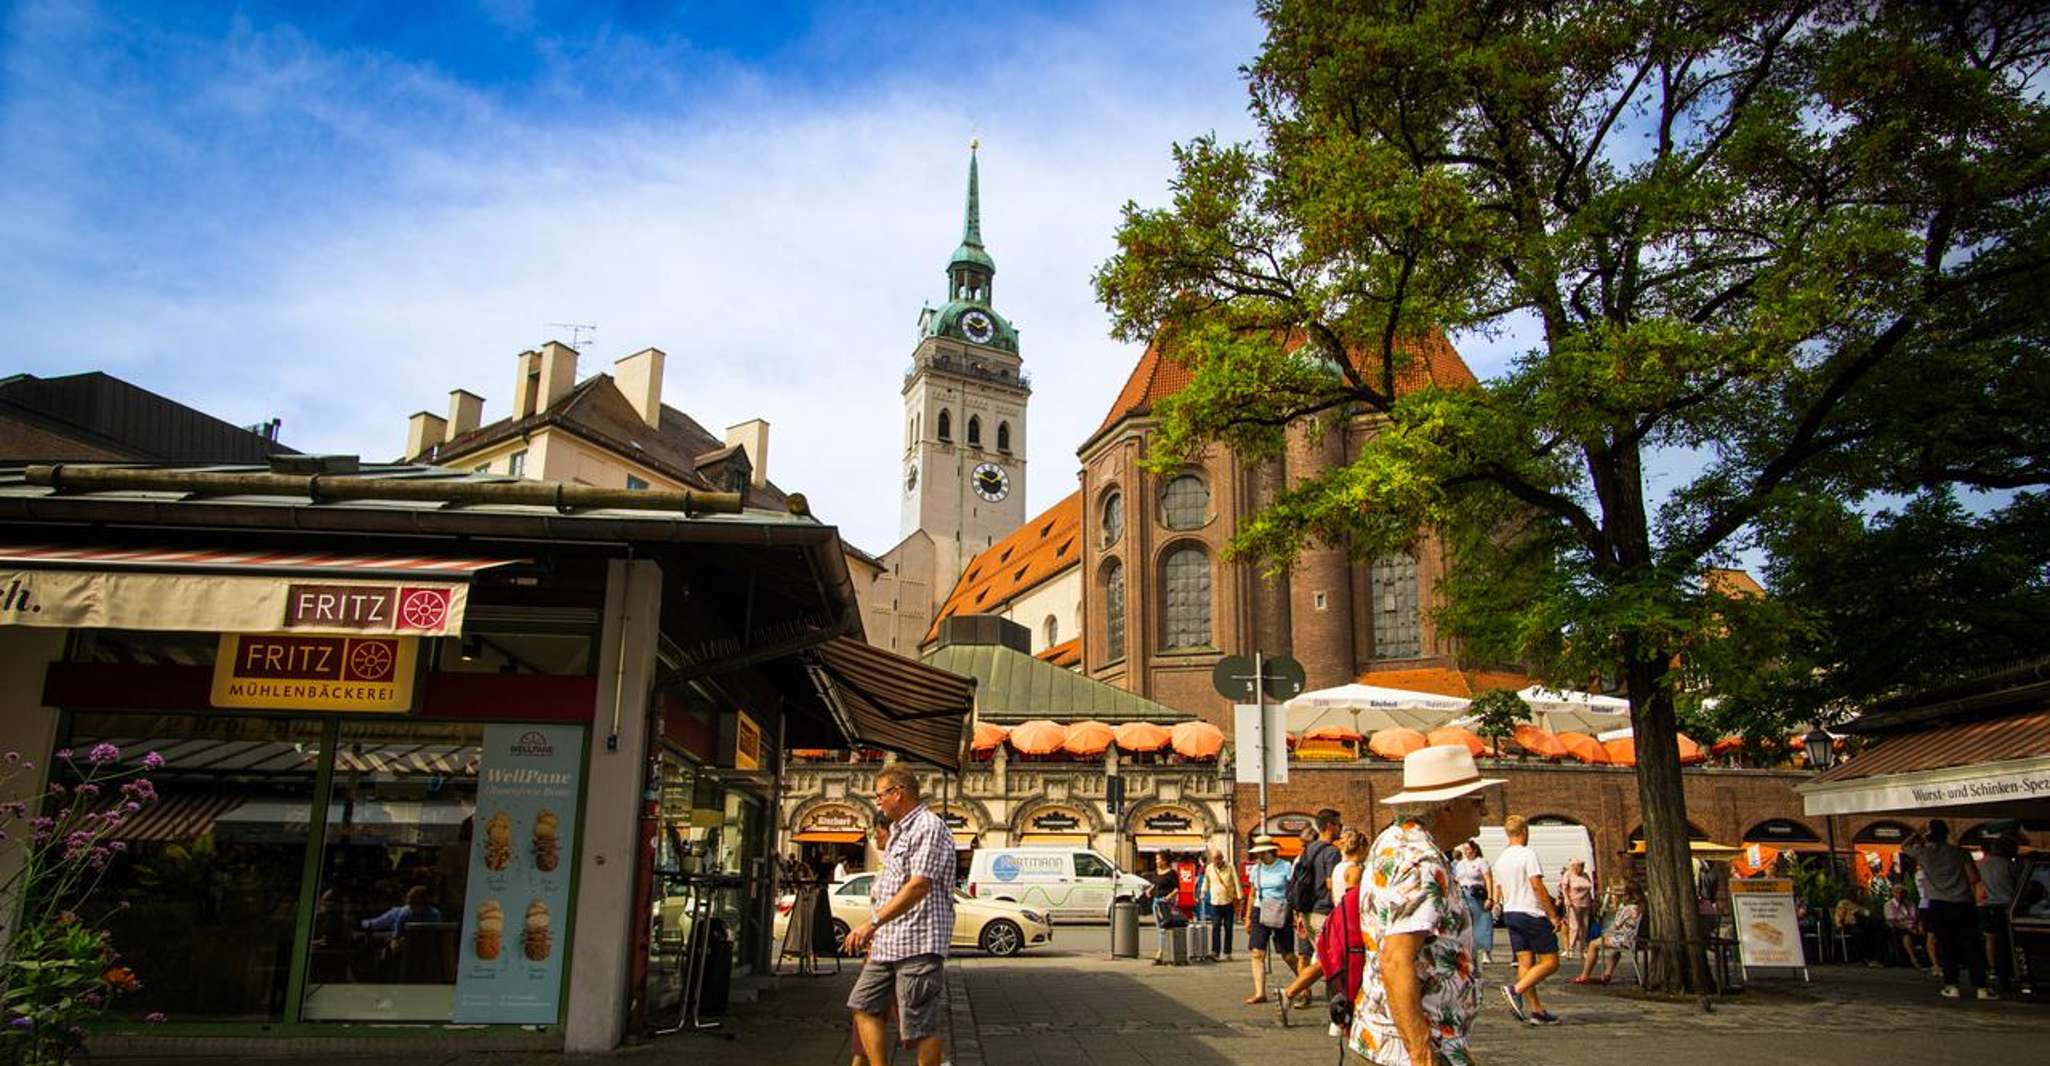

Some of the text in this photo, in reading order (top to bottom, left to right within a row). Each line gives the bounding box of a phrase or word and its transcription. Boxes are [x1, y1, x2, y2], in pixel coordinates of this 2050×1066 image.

[0, 580, 41, 612] h.
[297, 593, 386, 623] FRITZ
[246, 644, 333, 673] FRITZ
[228, 681, 395, 701] MÜHLENBÄCKEREI
[486, 767, 572, 785] WellPane
[1912, 789, 1946, 802] Wurst-
[1948, 785, 1968, 799] und
